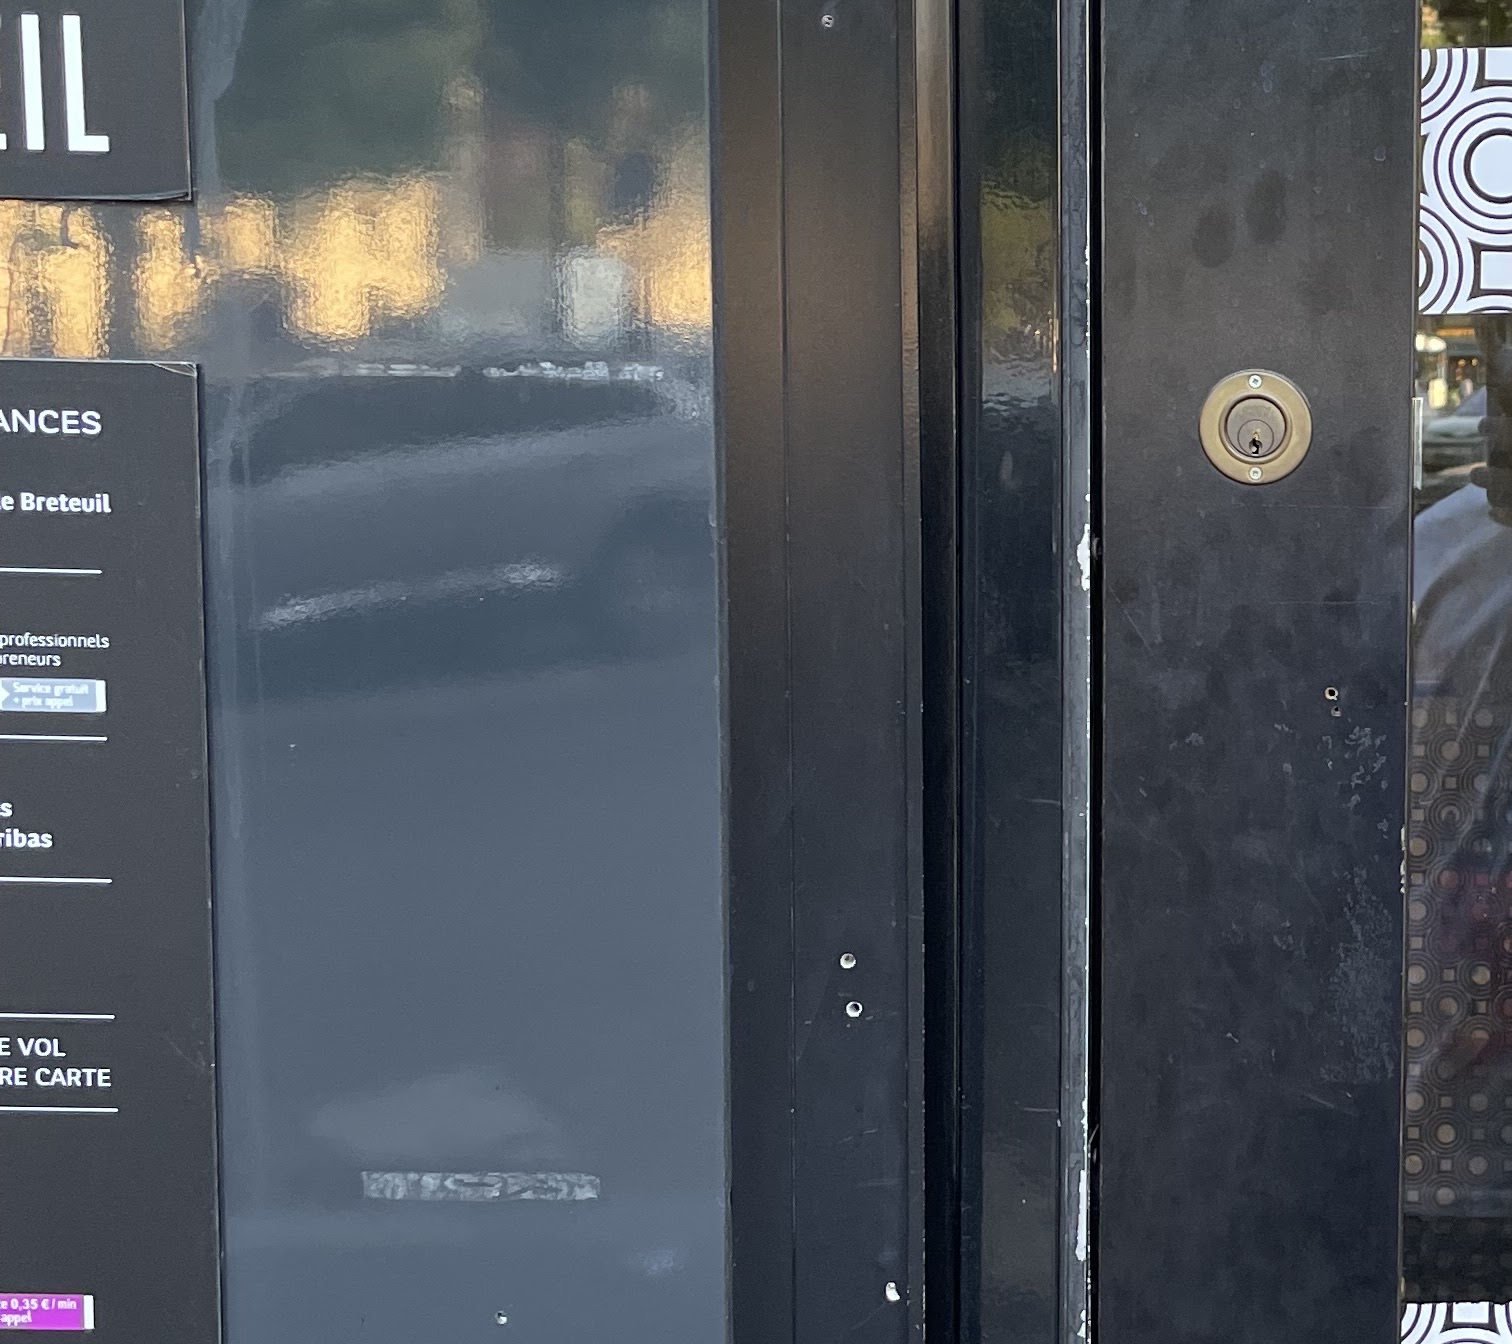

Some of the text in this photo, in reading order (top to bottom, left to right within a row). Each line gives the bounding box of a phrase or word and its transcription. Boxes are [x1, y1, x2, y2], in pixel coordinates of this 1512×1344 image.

[0, 13, 110, 153] IL
[20, 492, 112, 513] Breteuil
[0, 653, 62, 667] reneurs
[17, 1037, 67, 1057] VOL
[35, 1067, 112, 1087] CARTE
